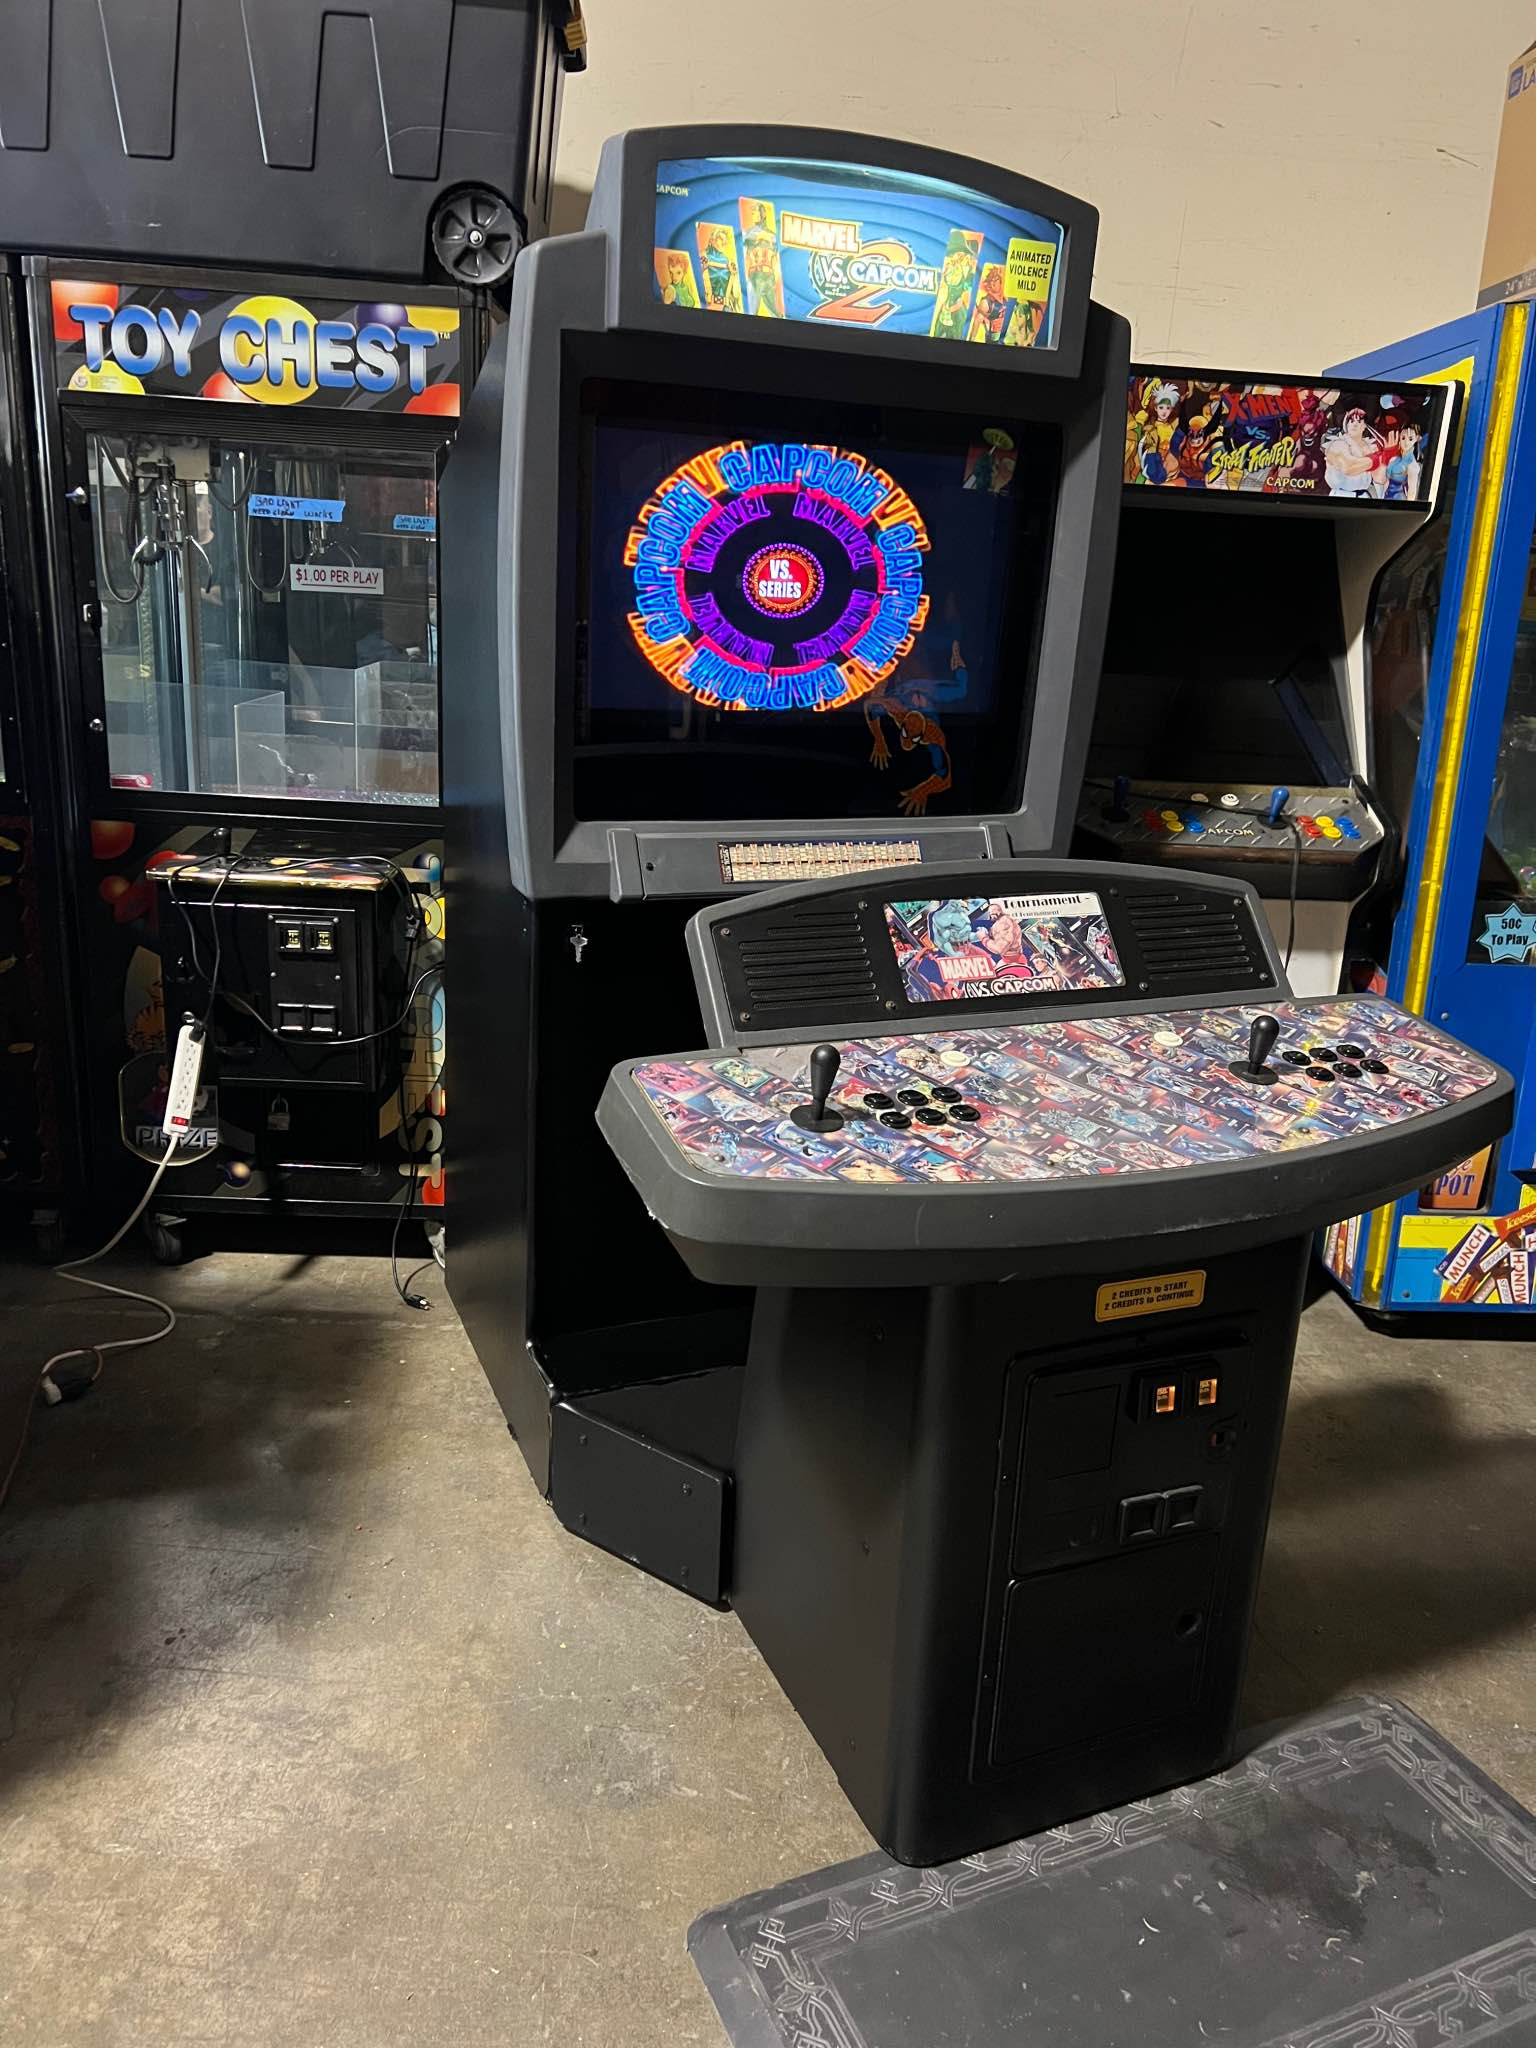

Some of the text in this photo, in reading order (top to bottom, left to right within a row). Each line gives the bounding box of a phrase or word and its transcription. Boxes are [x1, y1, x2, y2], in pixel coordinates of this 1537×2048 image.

[783, 214, 860, 254] MARVEL
[1010, 250, 1051, 265] ANIMATED
[849, 260, 936, 292] CAPCOM
[1010, 264, 1048, 279] VIOLENCE
[1018, 280, 1036, 291] MILD
[69, 304, 201, 377] TOY
[219, 314, 438, 395] CHEST
[1245, 425, 1271, 440] VS.
[719, 443, 889, 519] CAPCOM
[1266, 476, 1315, 489] CAPCOM
[296, 567, 379, 584] $1.00 PER PLAY
[769, 559, 793, 580] VS.
[758, 580, 802, 599] SERIES
[1207, 828, 1255, 836] APCOM
[1003, 895, 1082, 909] Tournament
[1491, 934, 1529, 945] To Play
[941, 956, 995, 980] MARVEL
[993, 977, 1057, 994] CAPCOM
[136, 1125, 217, 1148] PRZE
[1448, 1228, 1487, 1281] MUNCH
[1513, 1254, 1527, 1304] MUNCH
[1119, 1286, 1152, 1298] CREDITS
[1163, 1281, 1188, 1291] START
[1111, 1297, 1145, 1309] CREDITS
[1156, 1289, 1195, 1303] CONTINUE
